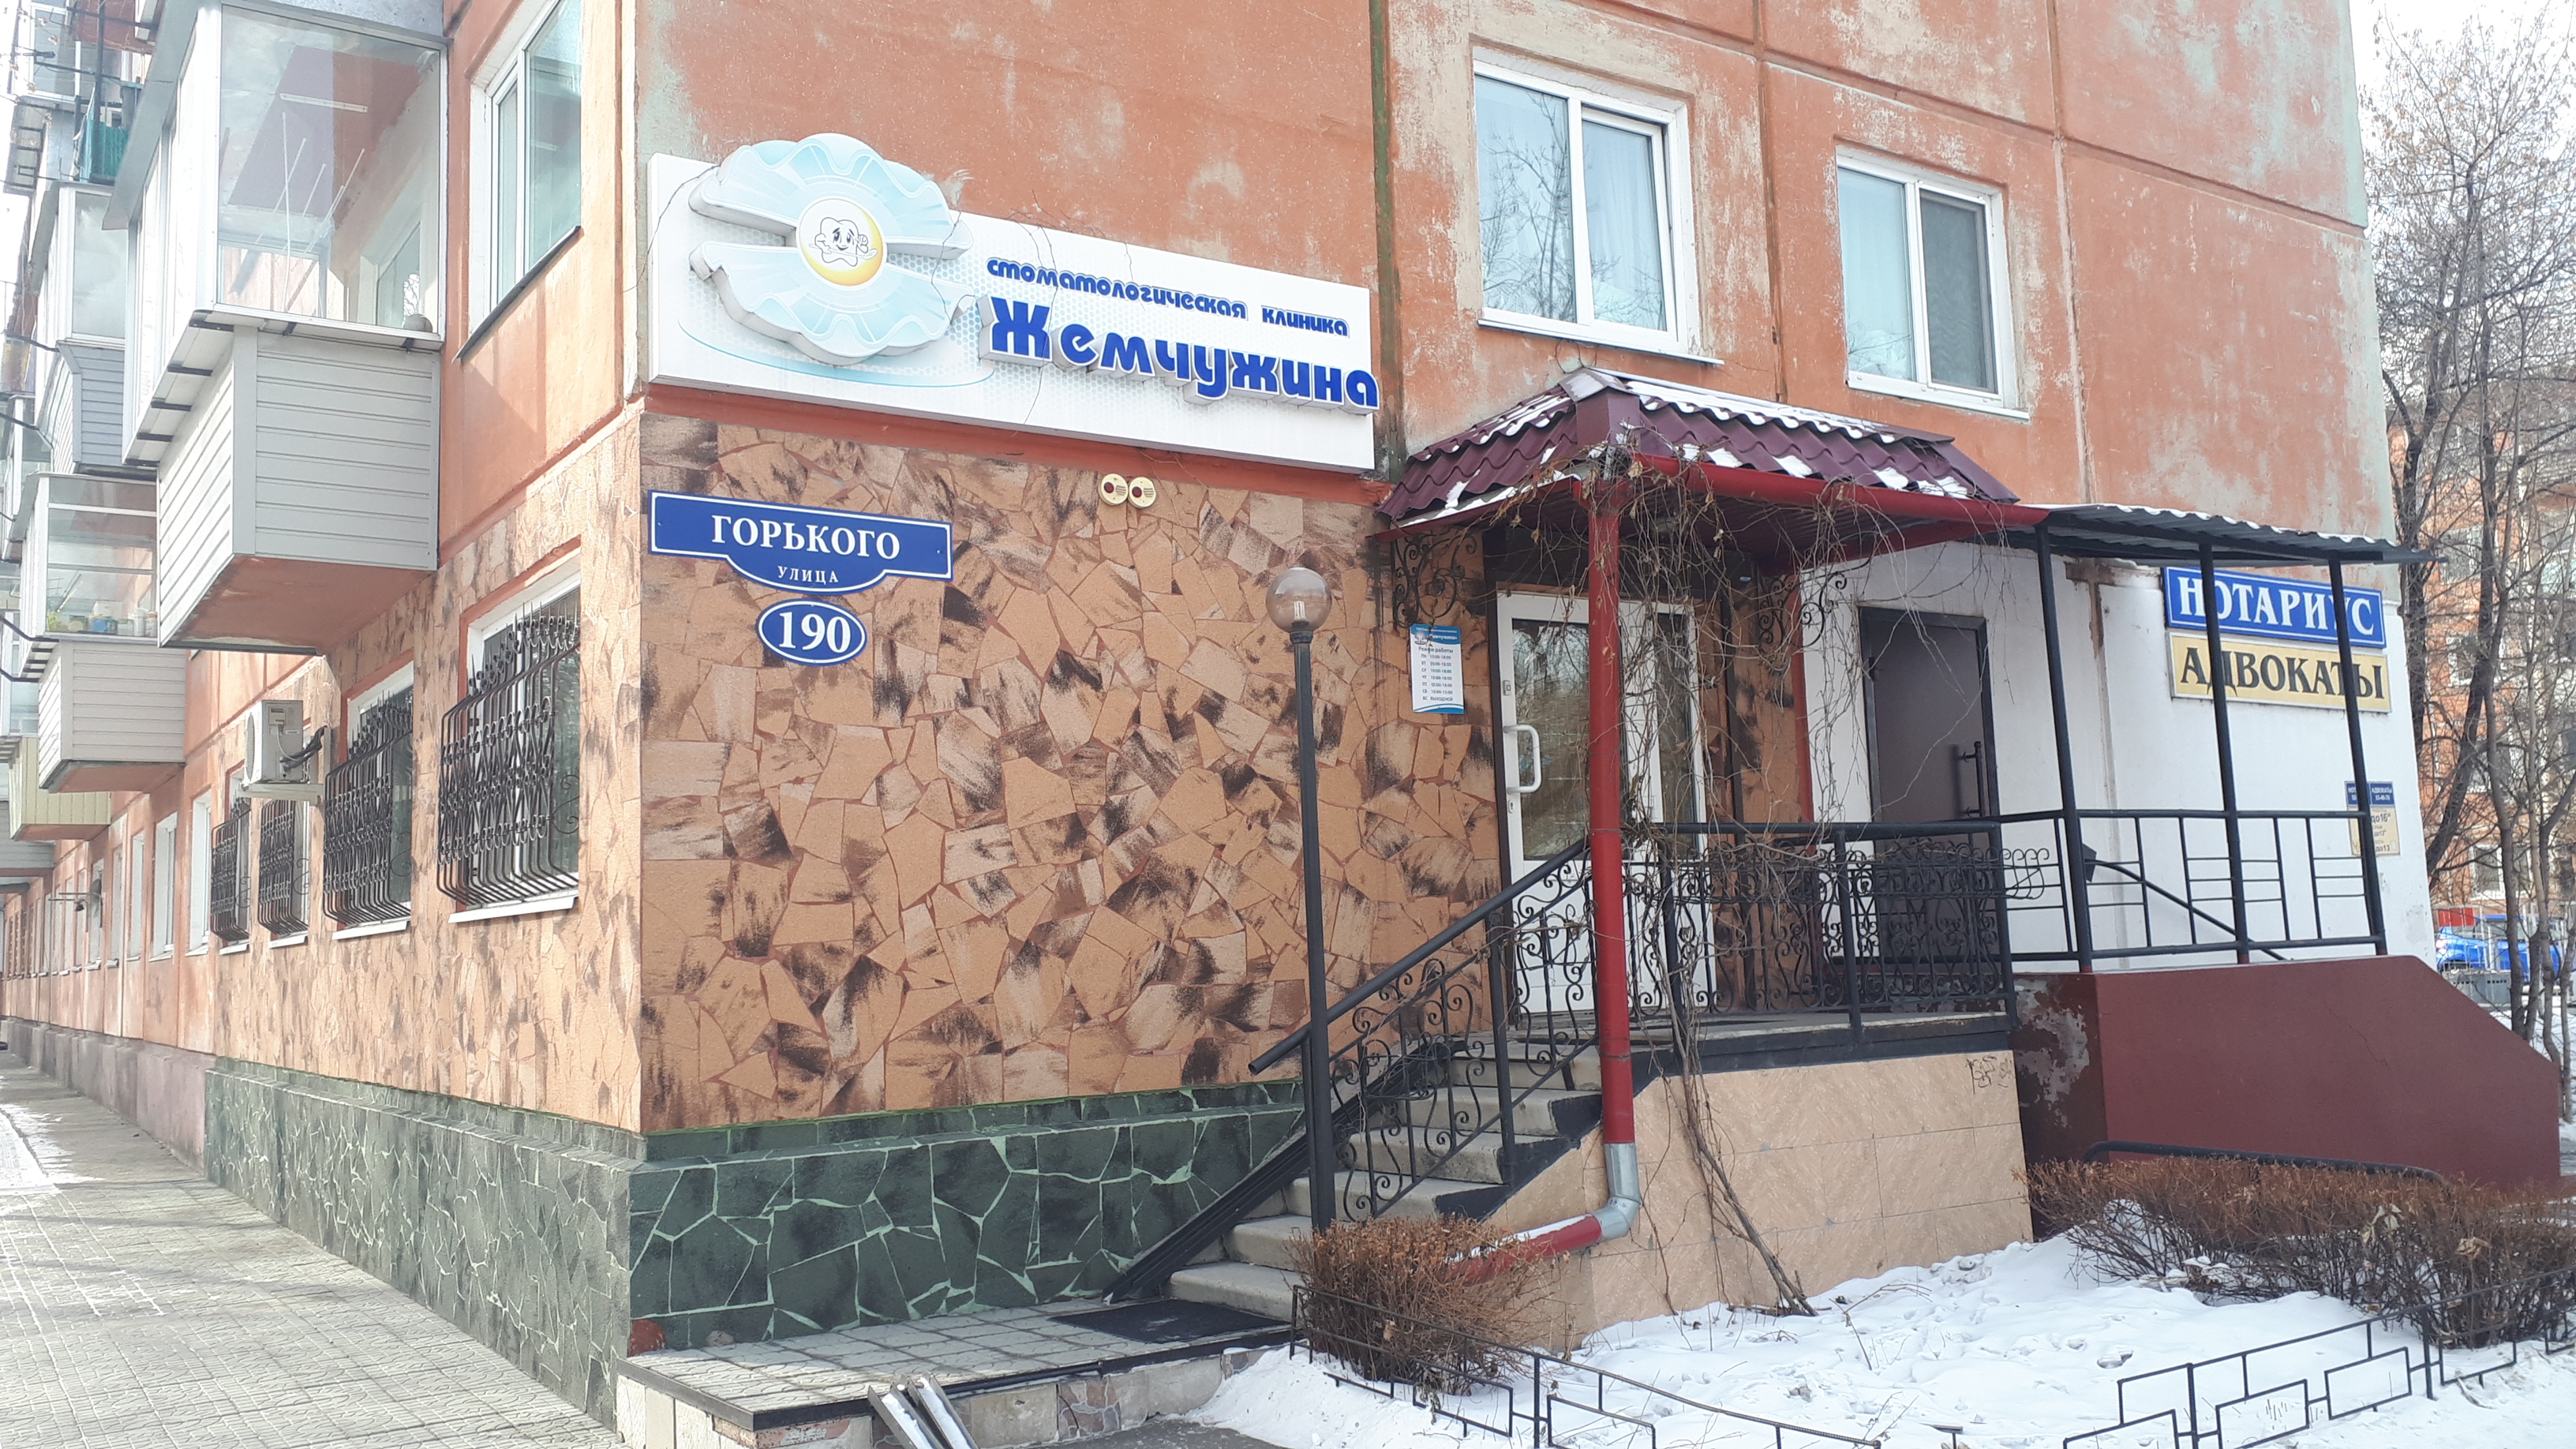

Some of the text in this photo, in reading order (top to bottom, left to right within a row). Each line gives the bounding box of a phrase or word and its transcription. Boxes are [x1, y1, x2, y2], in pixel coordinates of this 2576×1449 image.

[987, 257, 1350, 338] стоматологическая клиника
[990, 297, 1380, 409] Жемчужина
[711, 515, 900, 560] ГОРЬКОГО
[777, 565, 839, 585] УЛИЦА
[778, 612, 851, 653] 190
